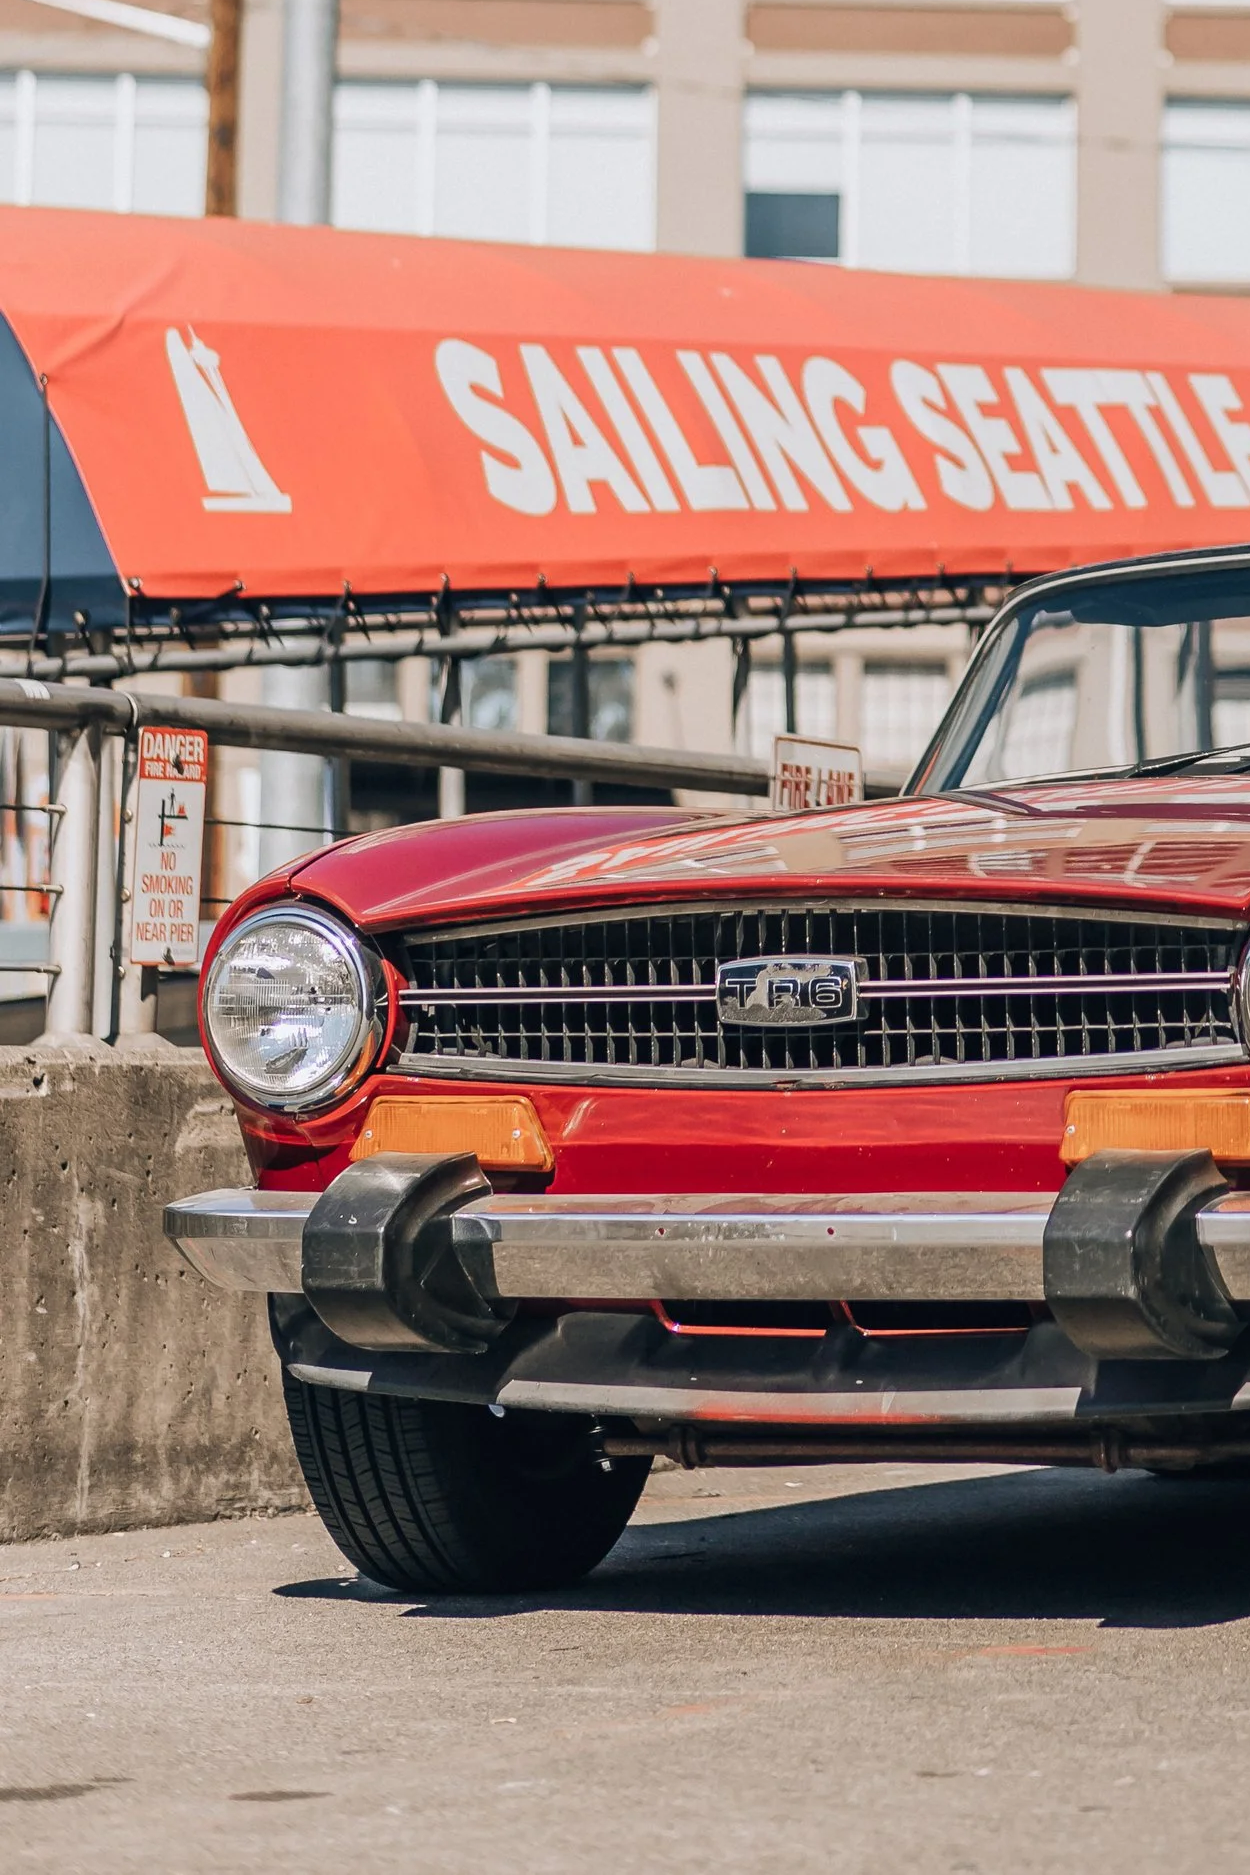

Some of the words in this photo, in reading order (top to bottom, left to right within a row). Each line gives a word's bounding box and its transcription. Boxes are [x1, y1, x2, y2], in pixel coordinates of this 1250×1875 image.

[434, 338, 927, 516] SAILING
[143, 731, 205, 763] DANGER
[144, 760, 165, 778] FIRE
[160, 852, 177, 872] NO
[141, 874, 194, 896] SMOKING
[149, 898, 166, 918] ON
[168, 899, 184, 920] OR
[136, 923, 166, 942] NEAR
[170, 924, 194, 943] PIER
[725, 975, 843, 1010] TR6
